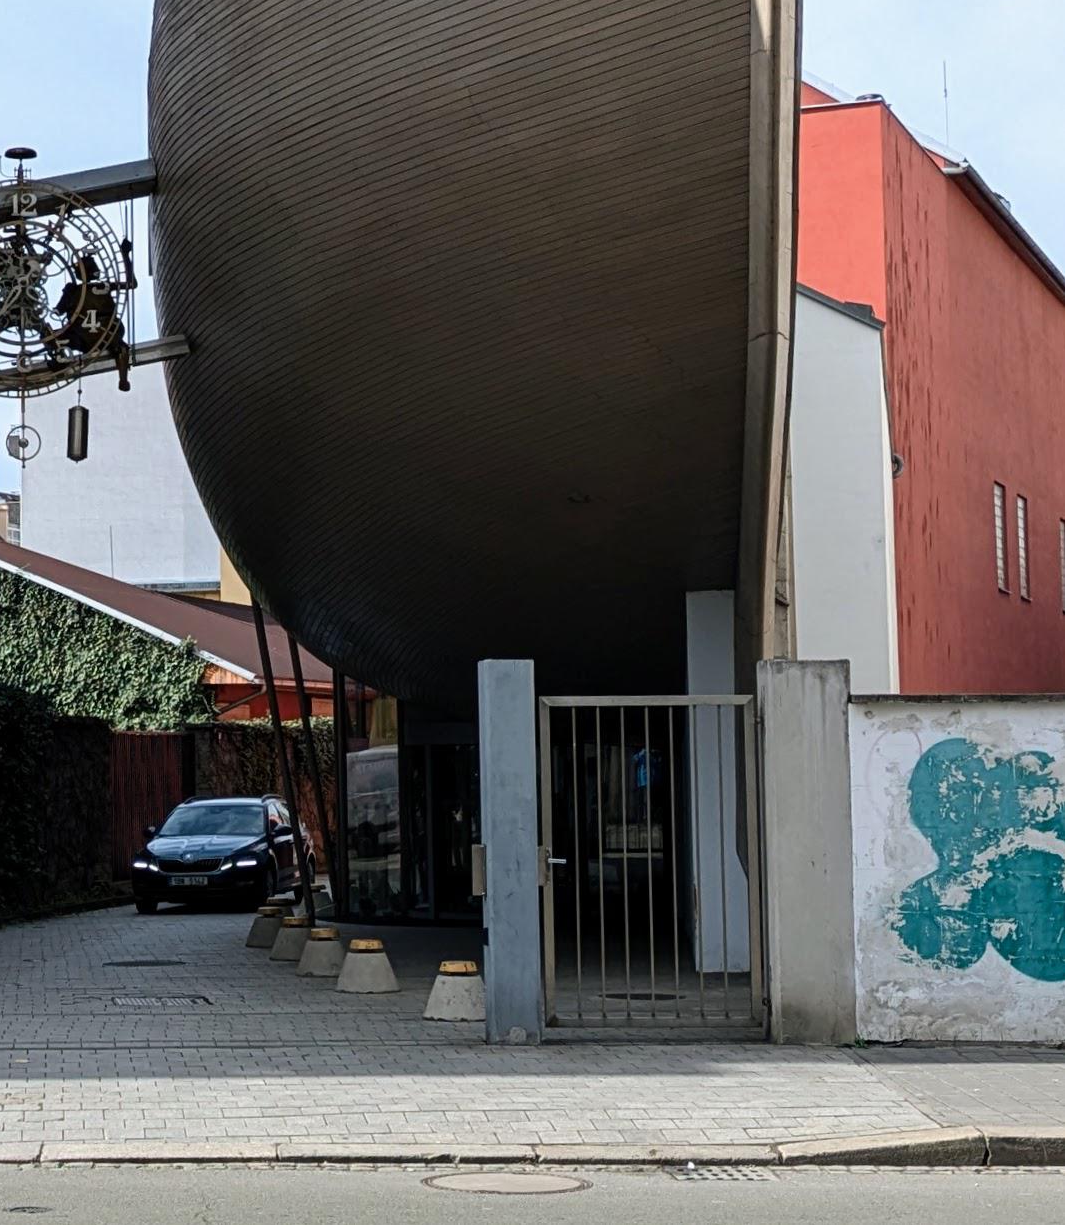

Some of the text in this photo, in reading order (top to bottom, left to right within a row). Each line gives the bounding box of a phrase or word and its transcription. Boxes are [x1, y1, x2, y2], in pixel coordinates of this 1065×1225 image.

[11, 192, 38, 217] 12
[81, 309, 102, 333] 4
[55, 339, 75, 364] 5
